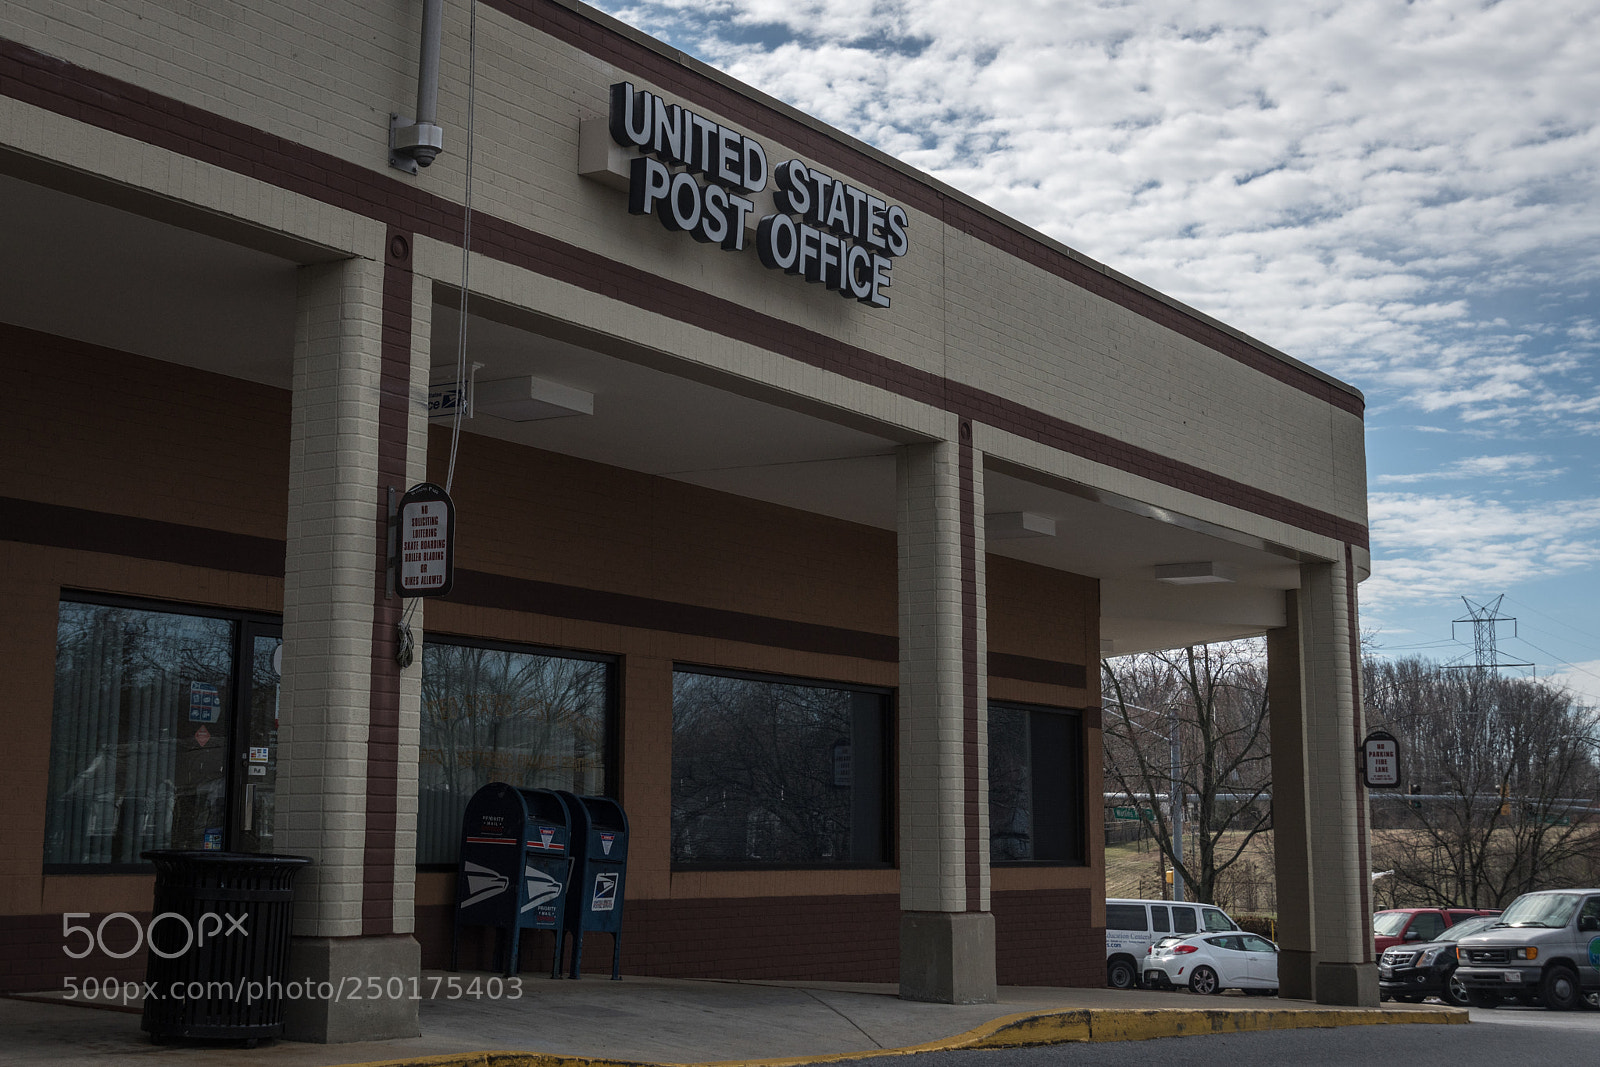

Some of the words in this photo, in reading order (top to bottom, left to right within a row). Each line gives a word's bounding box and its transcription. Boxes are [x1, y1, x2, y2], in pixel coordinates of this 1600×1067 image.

[610, 81, 768, 193] UNITED
[773, 158, 909, 257] STATES
[629, 157, 754, 251] POST
[757, 213, 892, 308] OFFICE
[421, 505, 429, 514] NO
[411, 516, 439, 527] SOLICITING
[412, 528, 438, 539] LOITERING
[404, 541, 419, 551] SKATE
[420, 539, 445, 550] BOARDING
[404, 552, 422, 563] ROLLER
[423, 551, 444, 562] BLADING
[420, 563, 428, 573] OR
[404, 576, 420, 586] BIKES
[421, 574, 443, 585] ALLOWED
